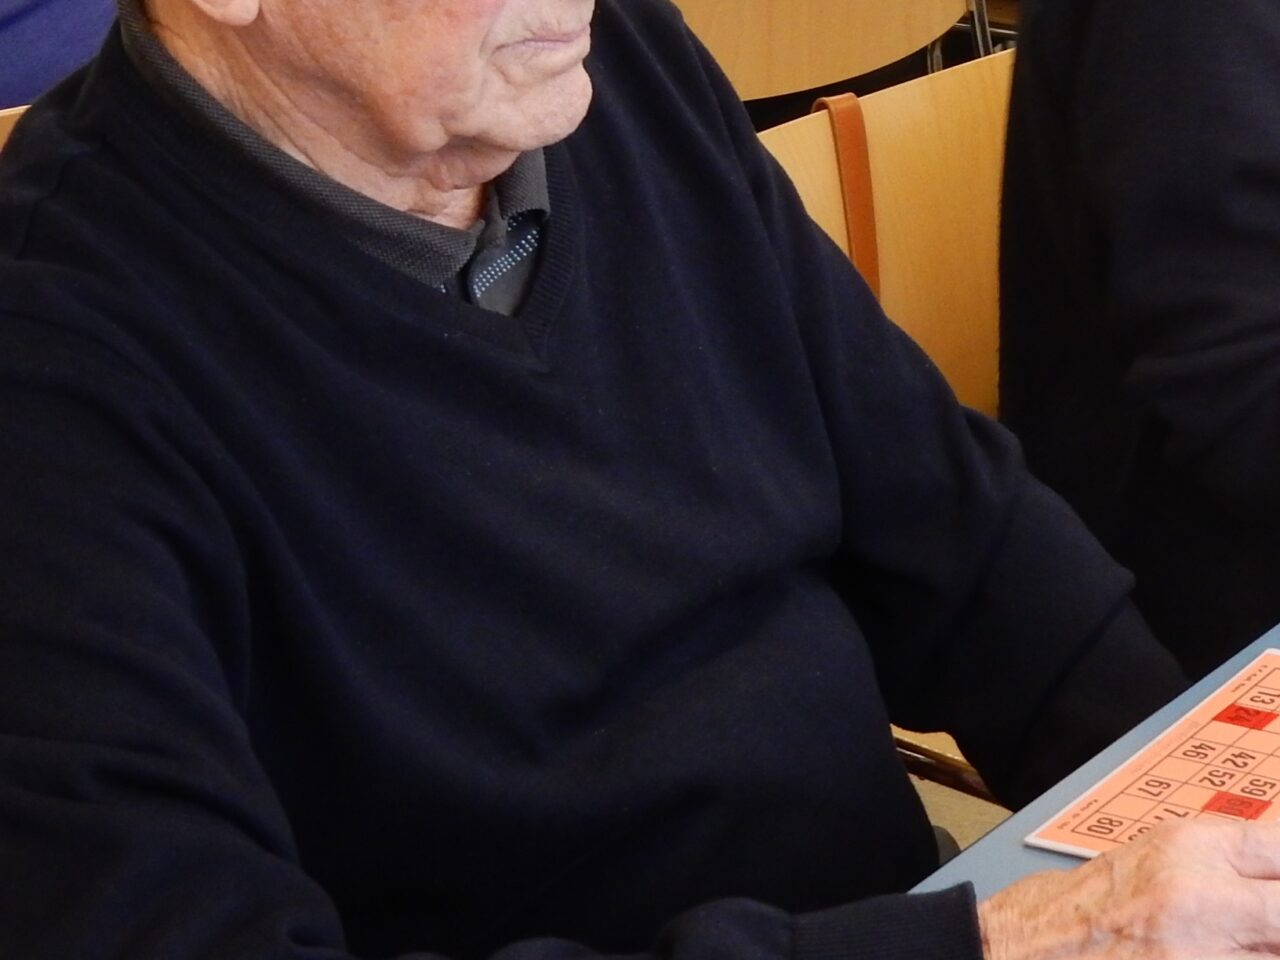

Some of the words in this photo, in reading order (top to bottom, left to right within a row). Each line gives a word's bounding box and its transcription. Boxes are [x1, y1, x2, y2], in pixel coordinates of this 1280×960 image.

[1249, 690, 1280, 705] 13
[1182, 742, 1217, 760] 46
[1221, 751, 1257, 770] 42
[1199, 768, 1236, 788] 52
[1240, 778, 1277, 797] 59
[1137, 778, 1172, 798] 67
[1087, 816, 1124, 836] 80
